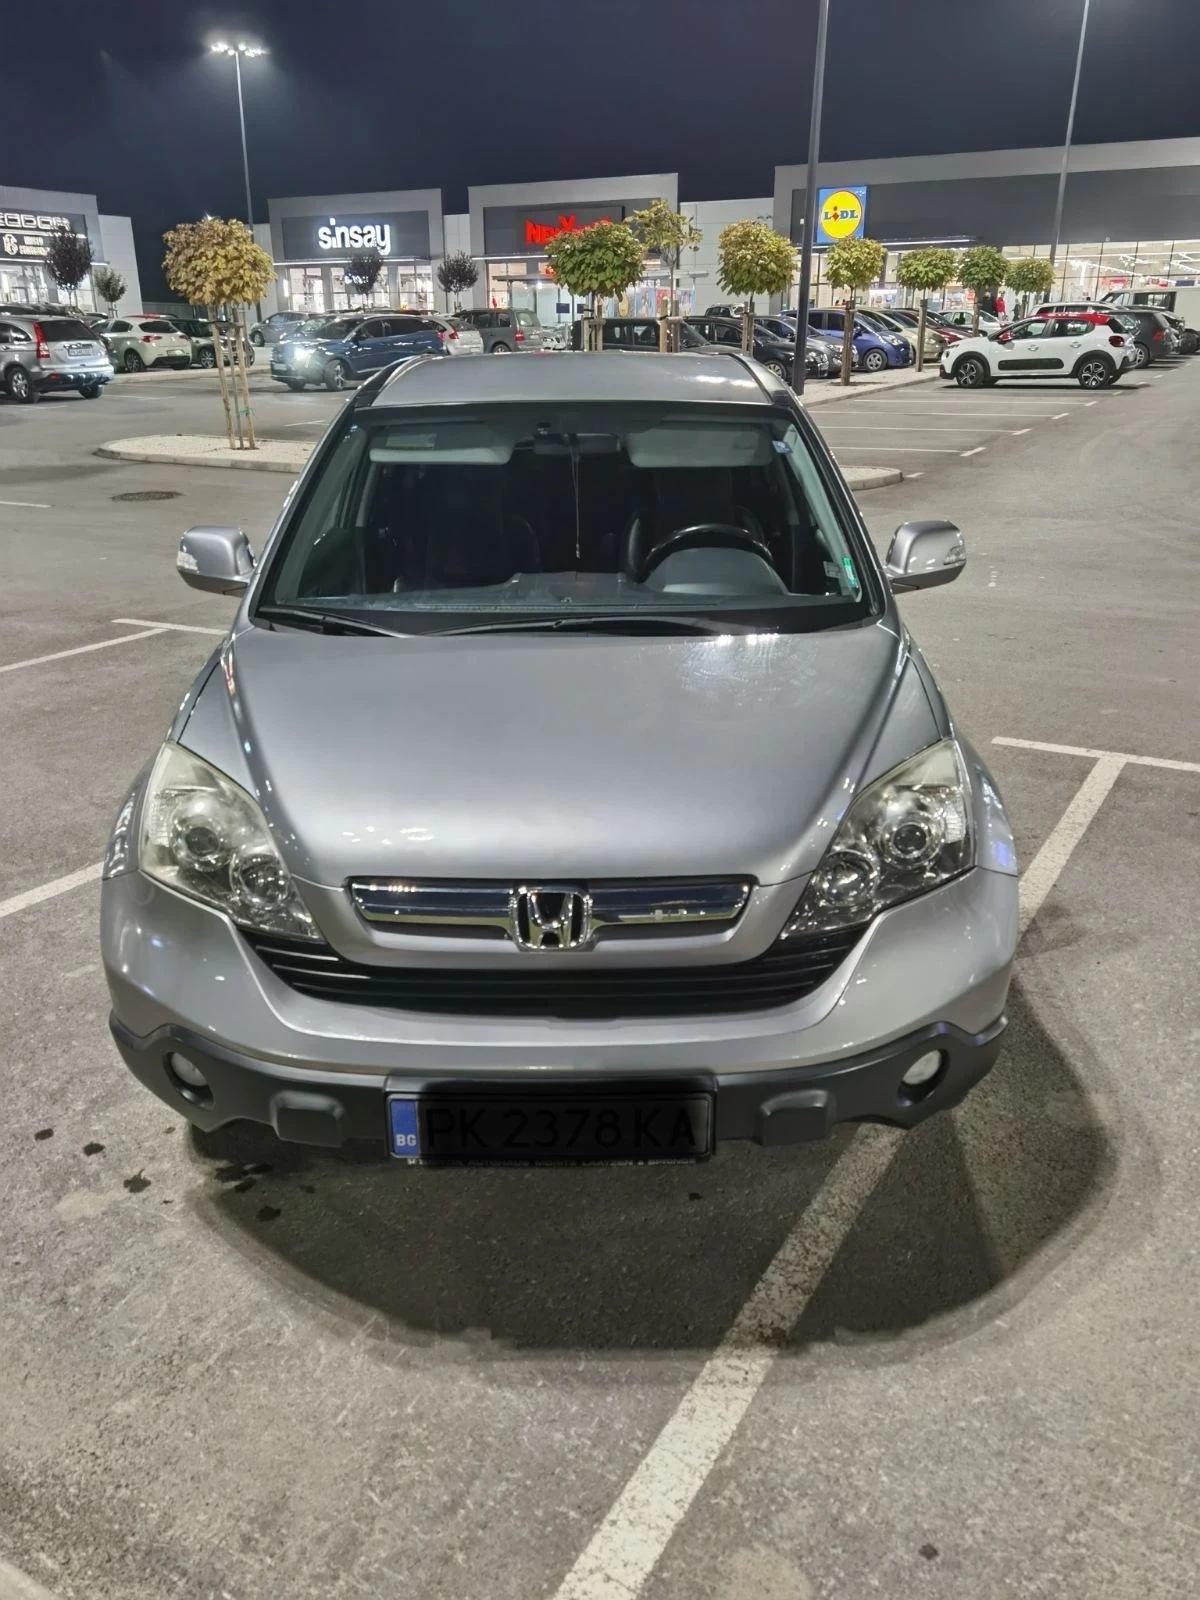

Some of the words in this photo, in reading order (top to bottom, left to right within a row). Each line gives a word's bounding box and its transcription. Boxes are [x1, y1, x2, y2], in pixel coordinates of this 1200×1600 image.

[318, 217, 391, 255] sinsay
[396, 1134, 417, 1147] BG
[425, 1107, 489, 1148] PK
[501, 1107, 621, 1148] 2378
[633, 1107, 697, 1148] KA
